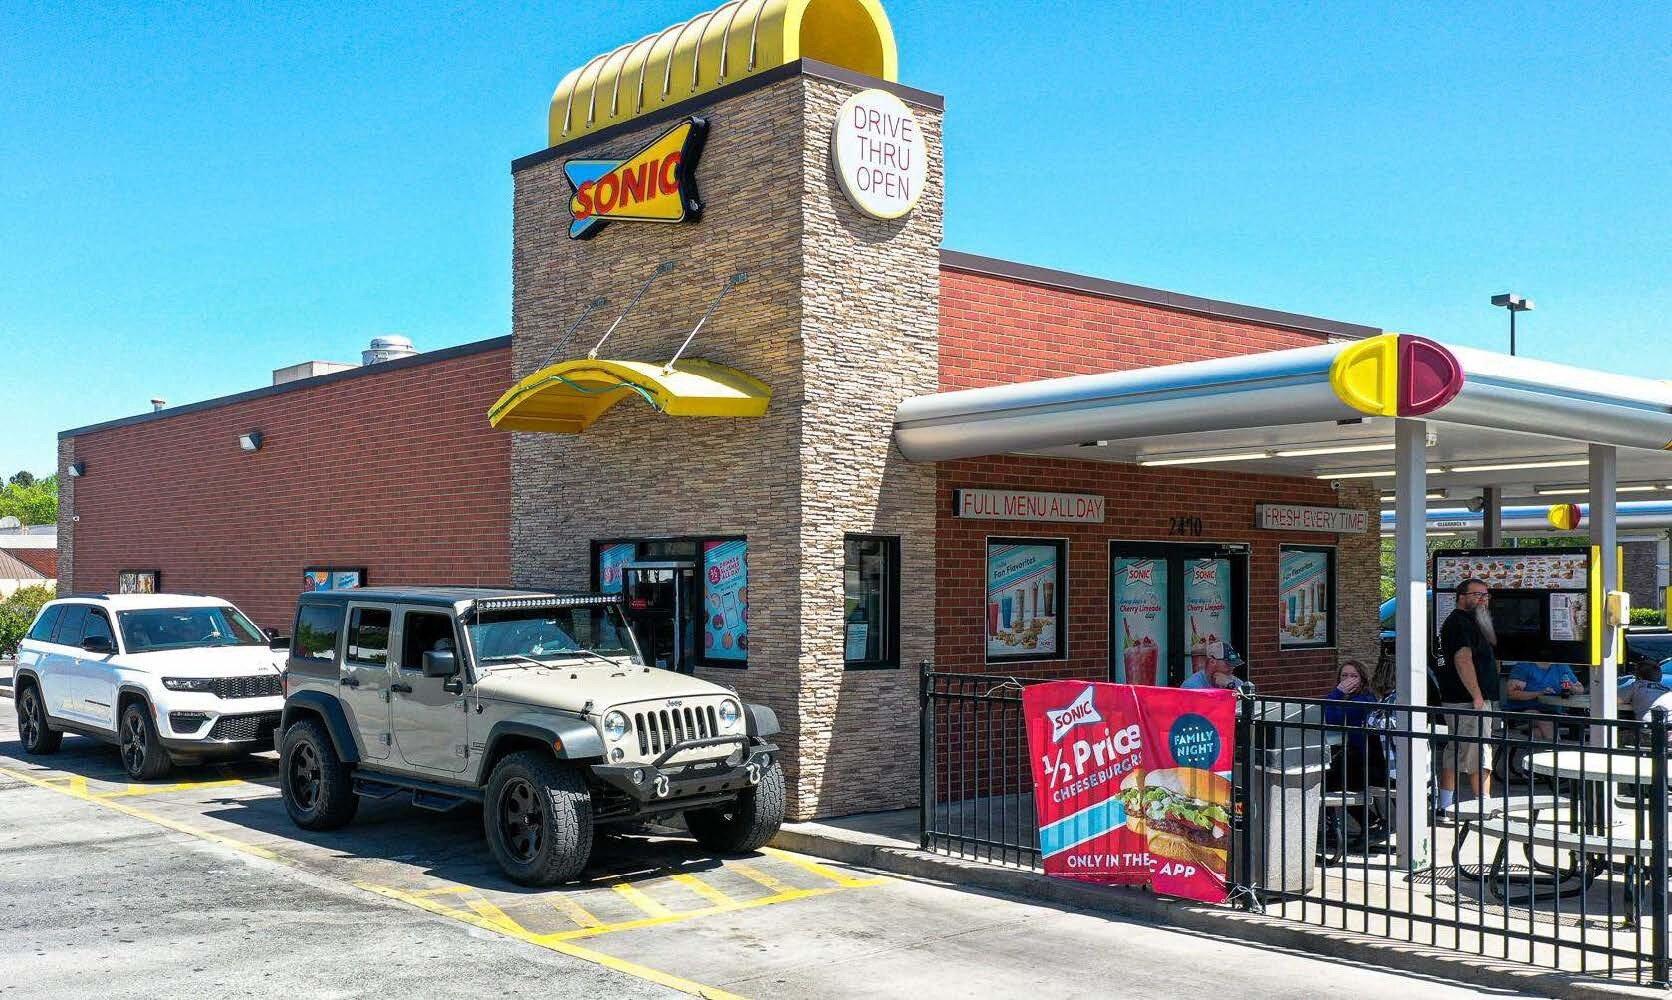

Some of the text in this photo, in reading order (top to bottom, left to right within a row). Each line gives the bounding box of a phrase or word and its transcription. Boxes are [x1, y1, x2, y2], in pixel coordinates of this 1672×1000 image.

[855, 106, 912, 142] DRIVE
[857, 135, 909, 171] THRU
[574, 151, 682, 220] SONIC
[857, 166, 909, 200] OPEN
[964, 493, 1103, 519] FULL MENU ALL DAY
[1265, 507, 1300, 527] FRESH
[1303, 510, 1337, 529] EVERY
[1129, 570, 1151, 579] SONIC
[1194, 570, 1216, 579] SONIC
[665, 699, 683, 707] Jeep
[1055, 700, 1092, 730] SONIC
[1174, 730, 1214, 745] FAMILY
[1177, 742, 1214, 757] NIGHT
[1073, 725, 1141, 776] Price
[1067, 855, 1103, 868] ONLY
[1105, 854, 1120, 868] IN
[1123, 853, 1150, 867] THE
[1160, 862, 1196, 877] APP
